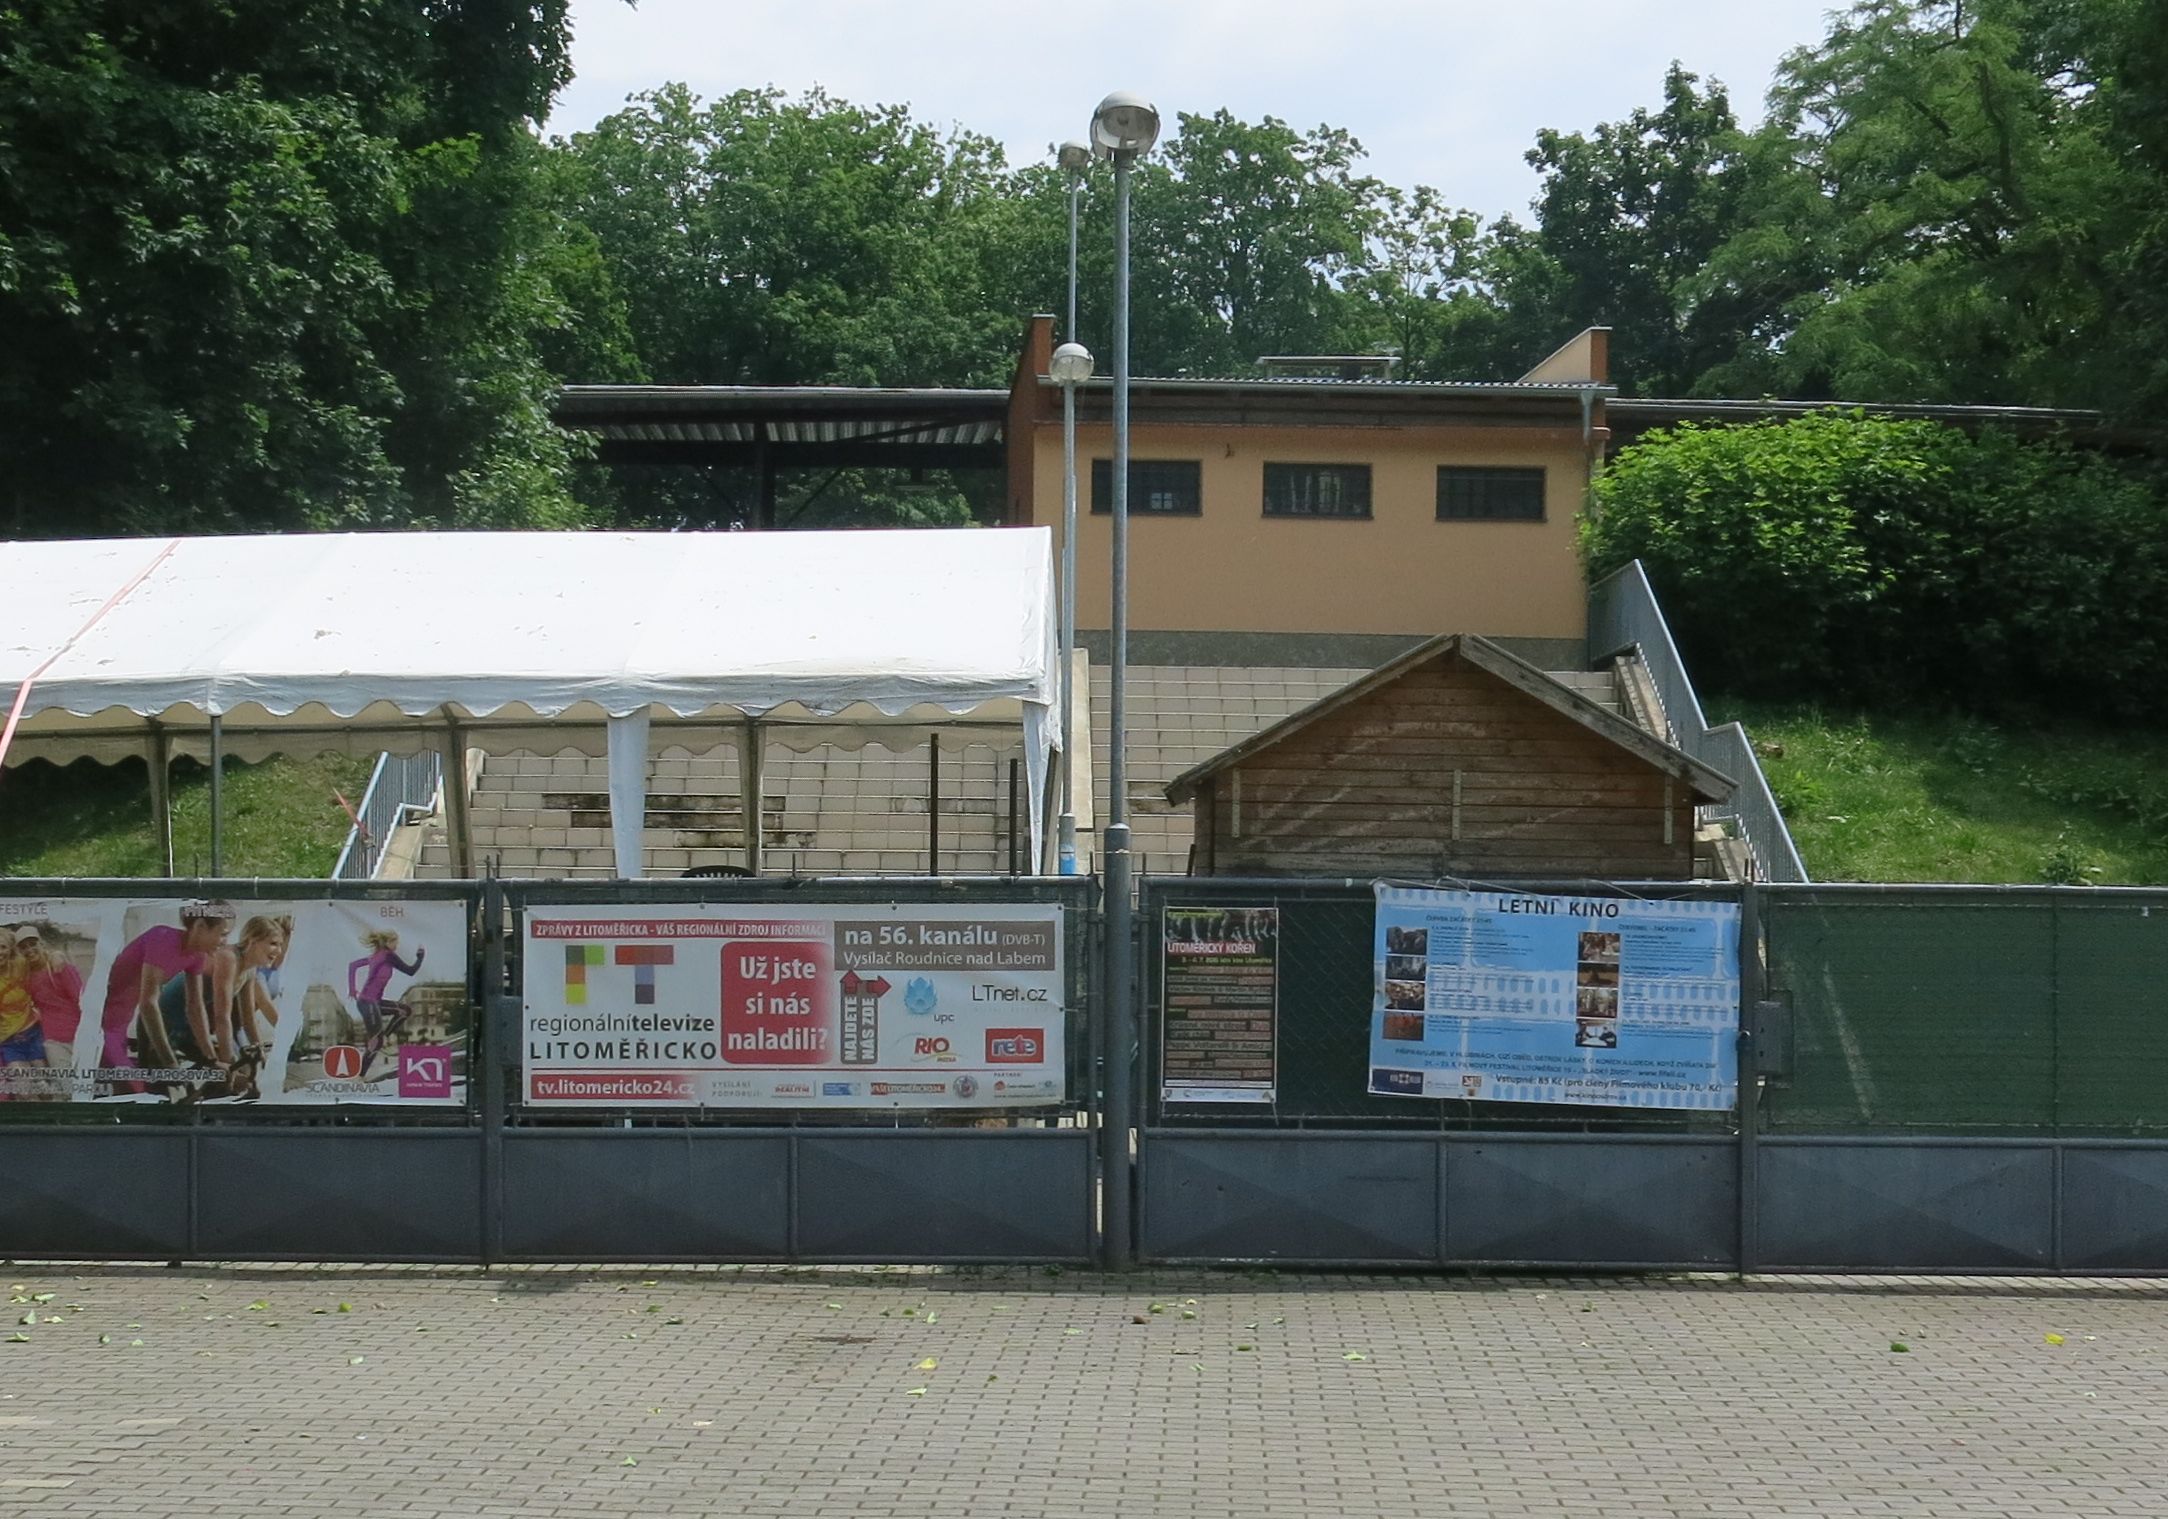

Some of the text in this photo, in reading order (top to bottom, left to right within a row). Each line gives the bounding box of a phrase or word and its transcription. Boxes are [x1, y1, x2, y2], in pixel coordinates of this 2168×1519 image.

[1569, 902, 1619, 918] KINO
[536, 923, 575, 936] ZPRÁVY
[575, 924, 582, 936] Z
[583, 922, 649, 936] LITOMĚŘICKA
[656, 922, 675, 936] VÁŠ
[676, 922, 736, 936] REGIONÁLNÍ
[738, 924, 769, 937] ZDROJ
[845, 925, 1046, 946] na 56. kanálu (DVB-T)
[844, 951, 1046, 967] Vysílač Roudnice nad Labem
[740, 956, 816, 985] Už jste
[746, 992, 810, 1015] si nás
[972, 985, 1048, 1002] LTnet.cz
[530, 1013, 715, 1036] regionálnítelevize
[844, 995, 858, 1060] NAJDETE
[860, 997, 875, 1060] NÁS ZDE
[934, 1013, 955, 1024] upc
[529, 1038, 717, 1060] LITOMĚŘICKO
[728, 1027, 828, 1050] naladili?
[914, 1037, 950, 1055] RIO
[537, 1079, 695, 1095] tv.litomericko24.cz
